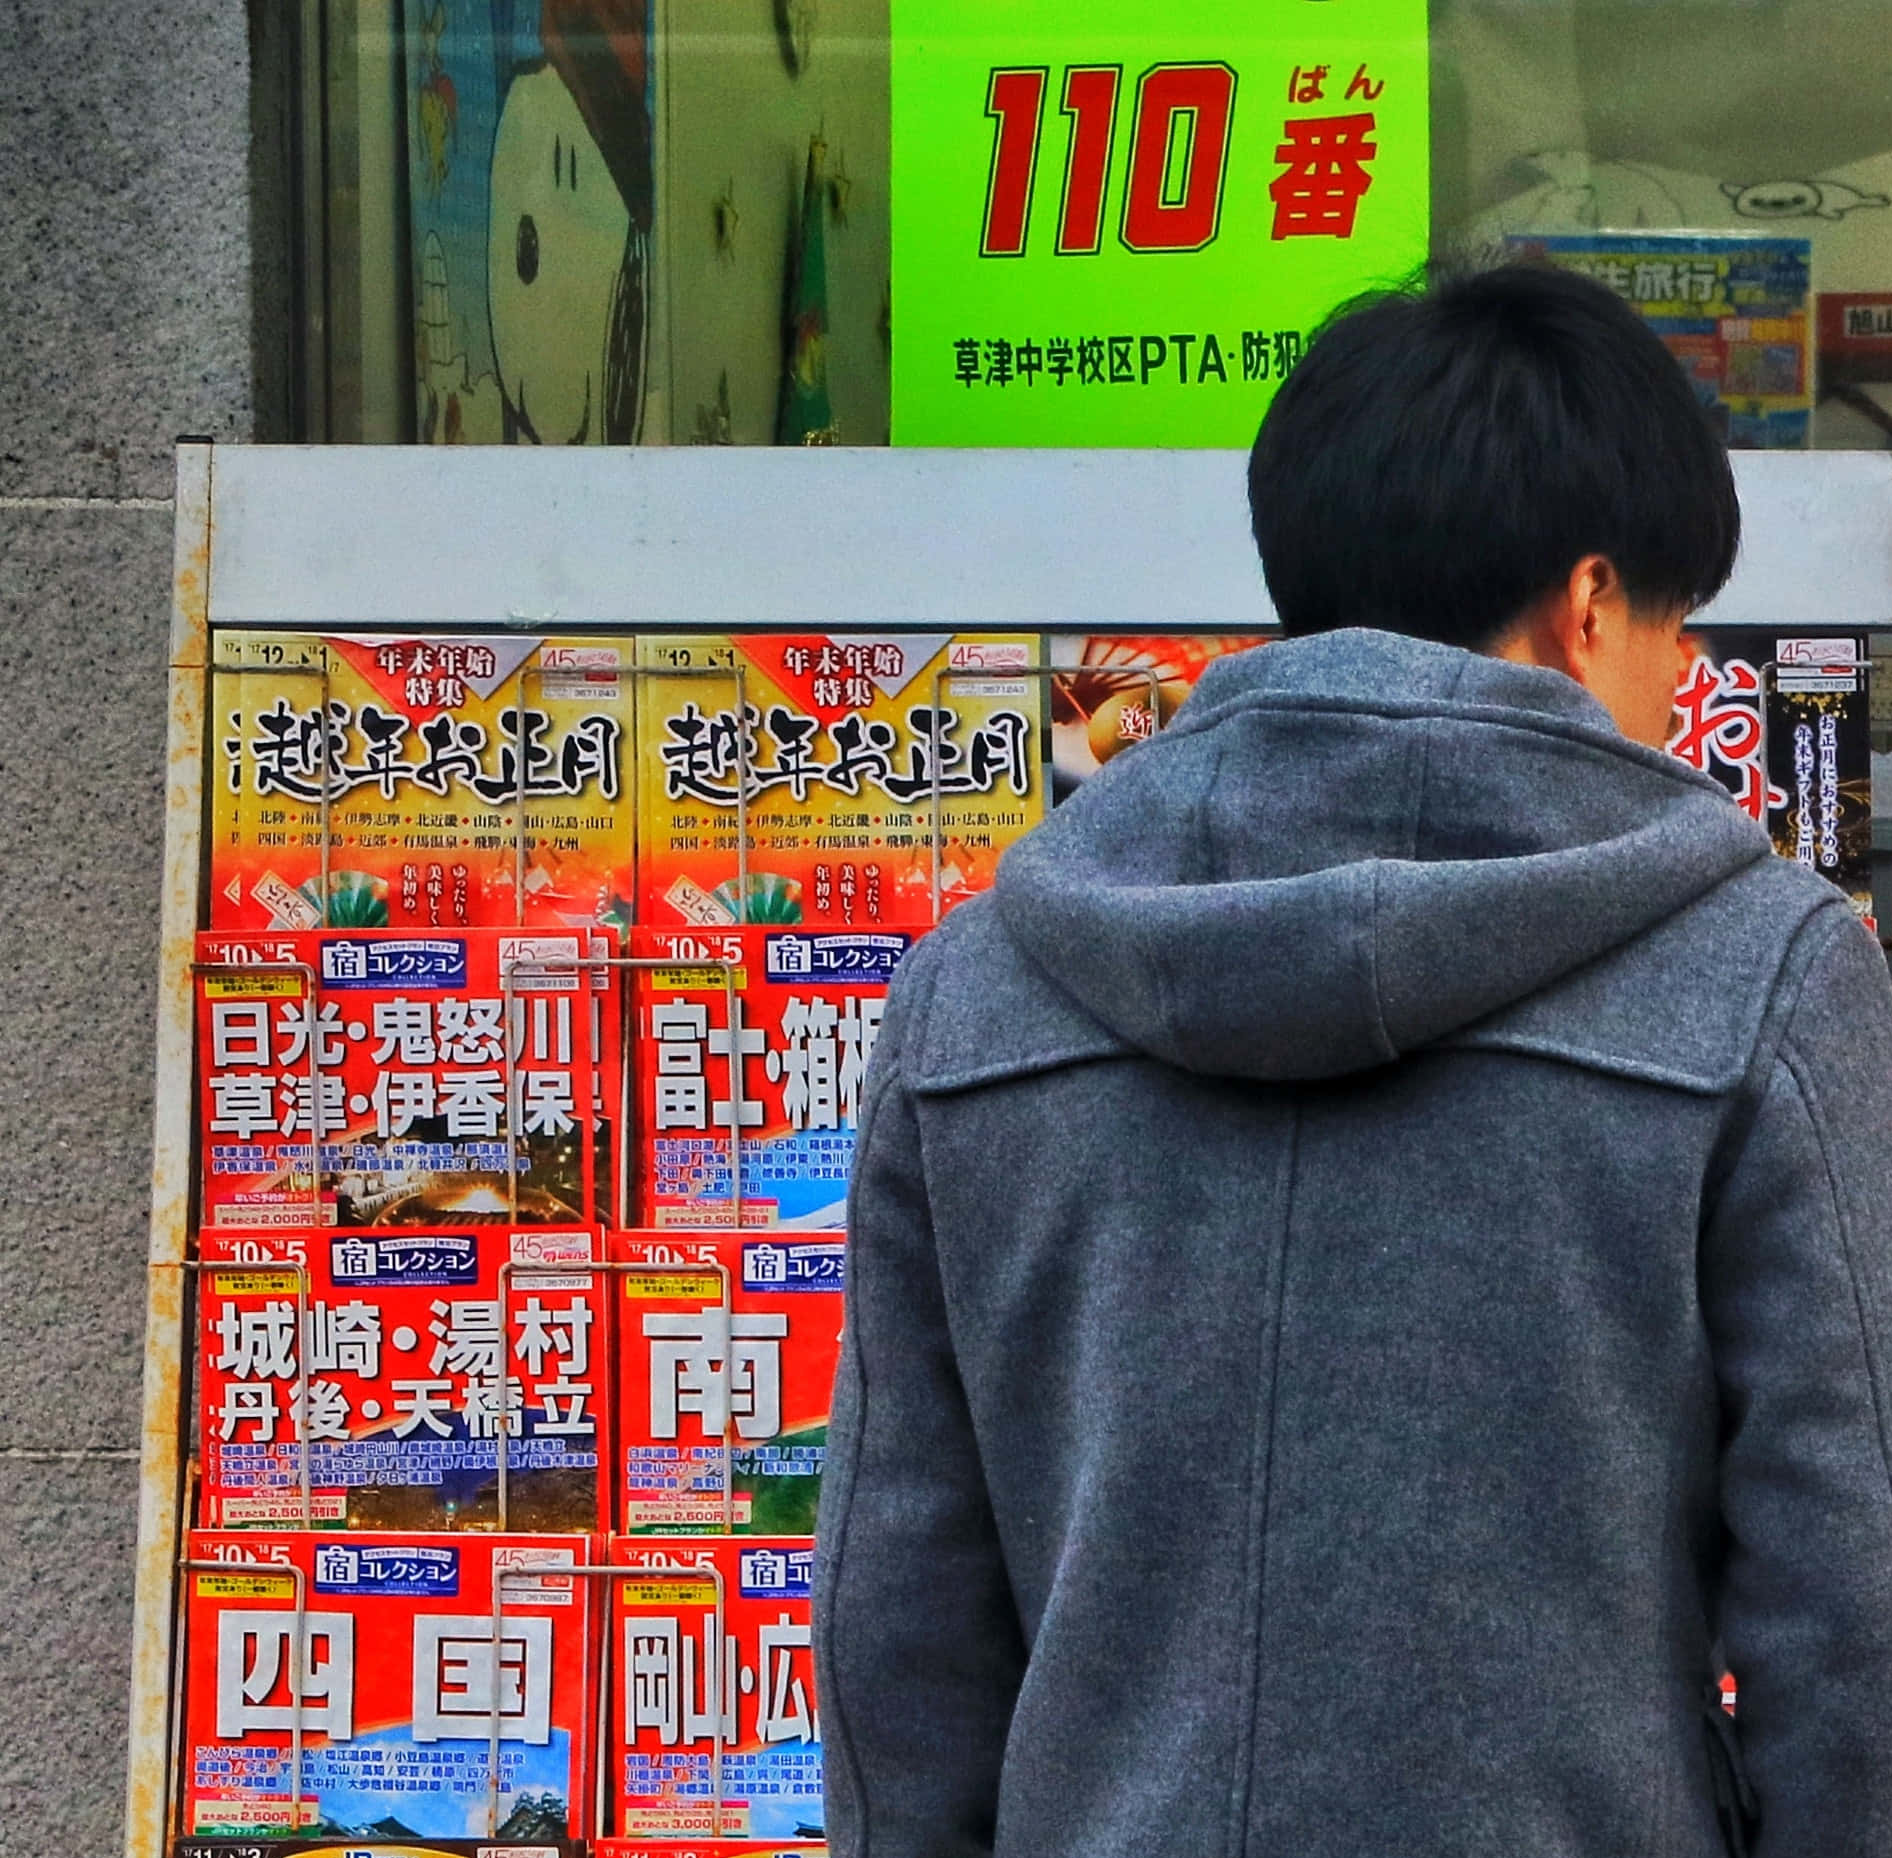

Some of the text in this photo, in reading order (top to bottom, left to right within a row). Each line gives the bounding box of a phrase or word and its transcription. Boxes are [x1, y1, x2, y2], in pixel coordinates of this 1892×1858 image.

[1287, 64, 1383, 103] ばん
[953, 330, 1311, 386] 草津中学校区PTA・防犯
[376, 646, 495, 676] 年末年始
[407, 678, 463, 706] 特集
[216, 1611, 552, 1744] 四国
